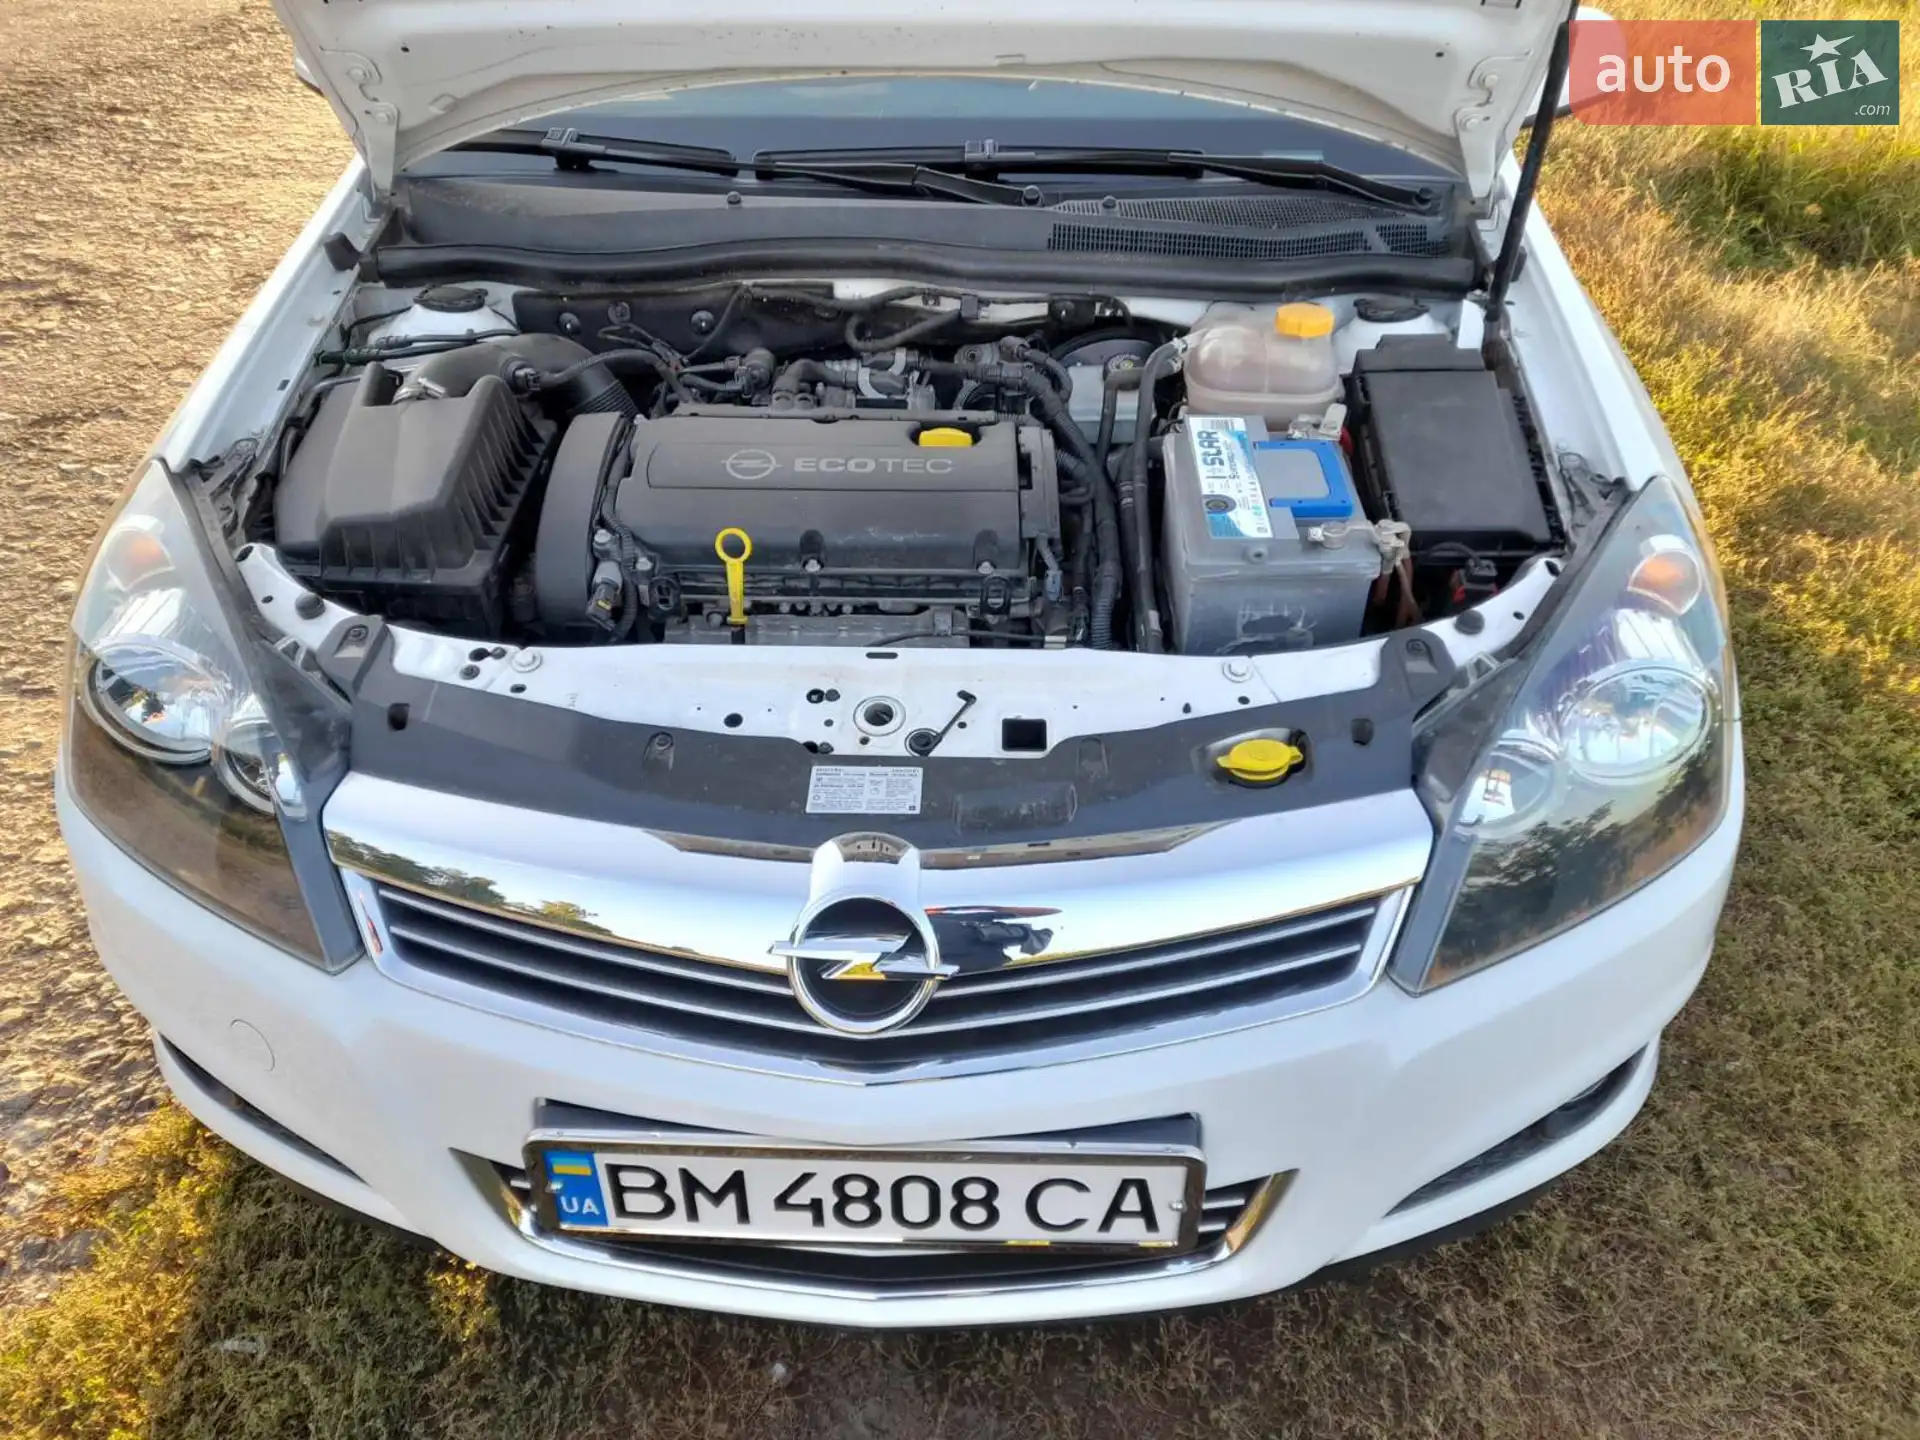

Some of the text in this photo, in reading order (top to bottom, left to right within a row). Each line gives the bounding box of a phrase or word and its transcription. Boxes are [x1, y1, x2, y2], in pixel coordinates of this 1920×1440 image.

[793, 457, 954, 475] ECOTEC
[560, 1196, 600, 1216] UA
[604, 1162, 1161, 1234] BM 4808 CA
